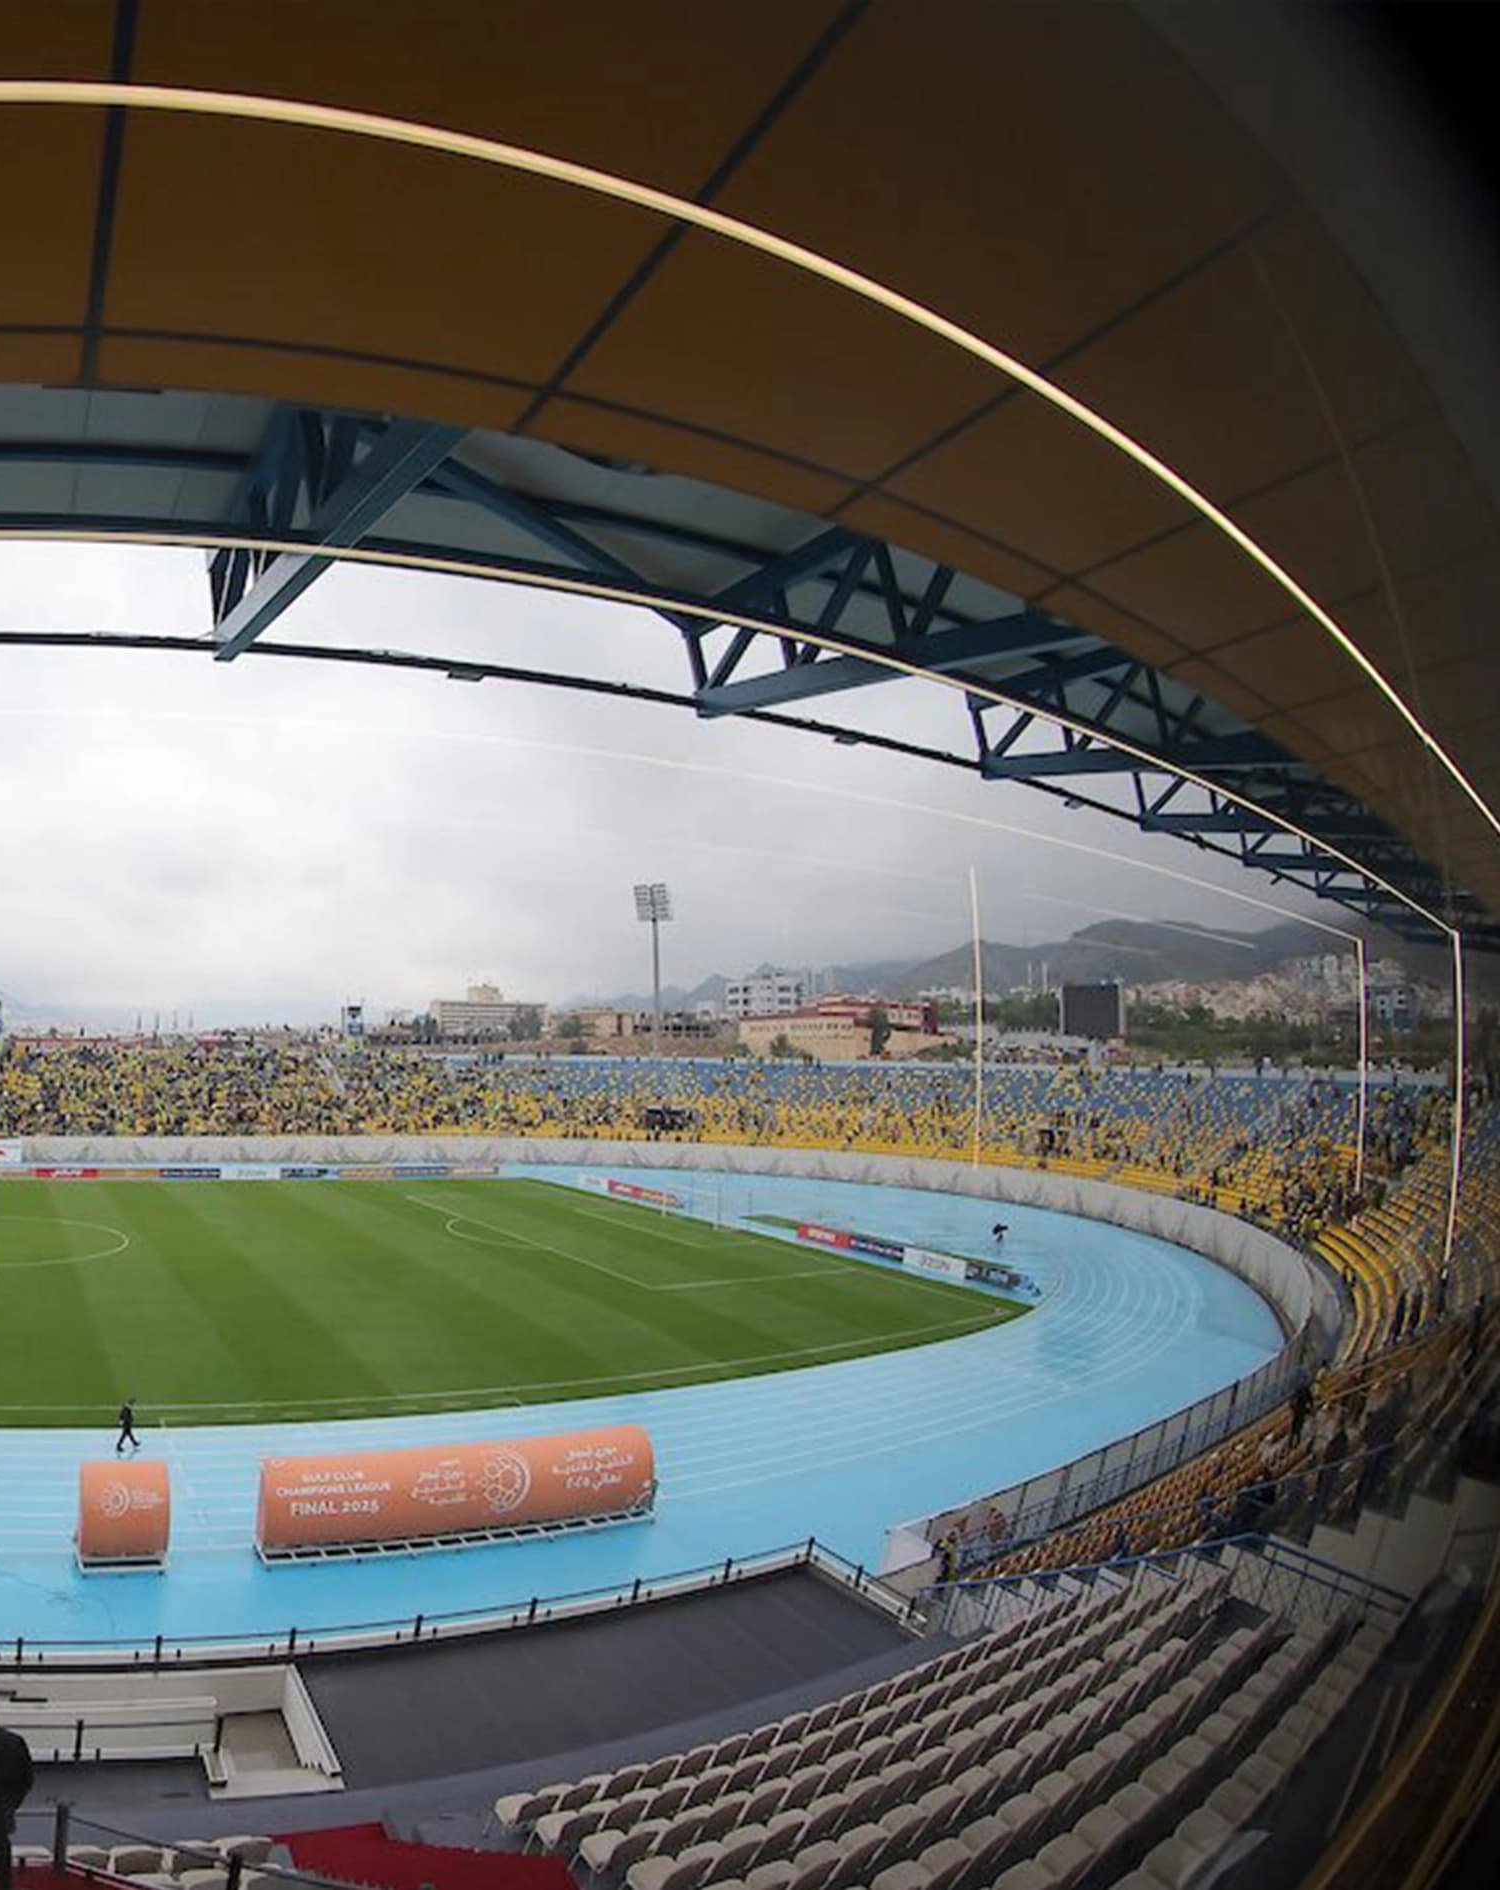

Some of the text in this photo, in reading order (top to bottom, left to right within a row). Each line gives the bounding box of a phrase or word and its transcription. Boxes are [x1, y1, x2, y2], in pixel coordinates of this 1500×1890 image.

[302, 1471, 364, 1483] GULF CLUB
[275, 1481, 392, 1498] CHAMPIONS LEAGUE
[291, 1498, 380, 1517] FINAL 2025
